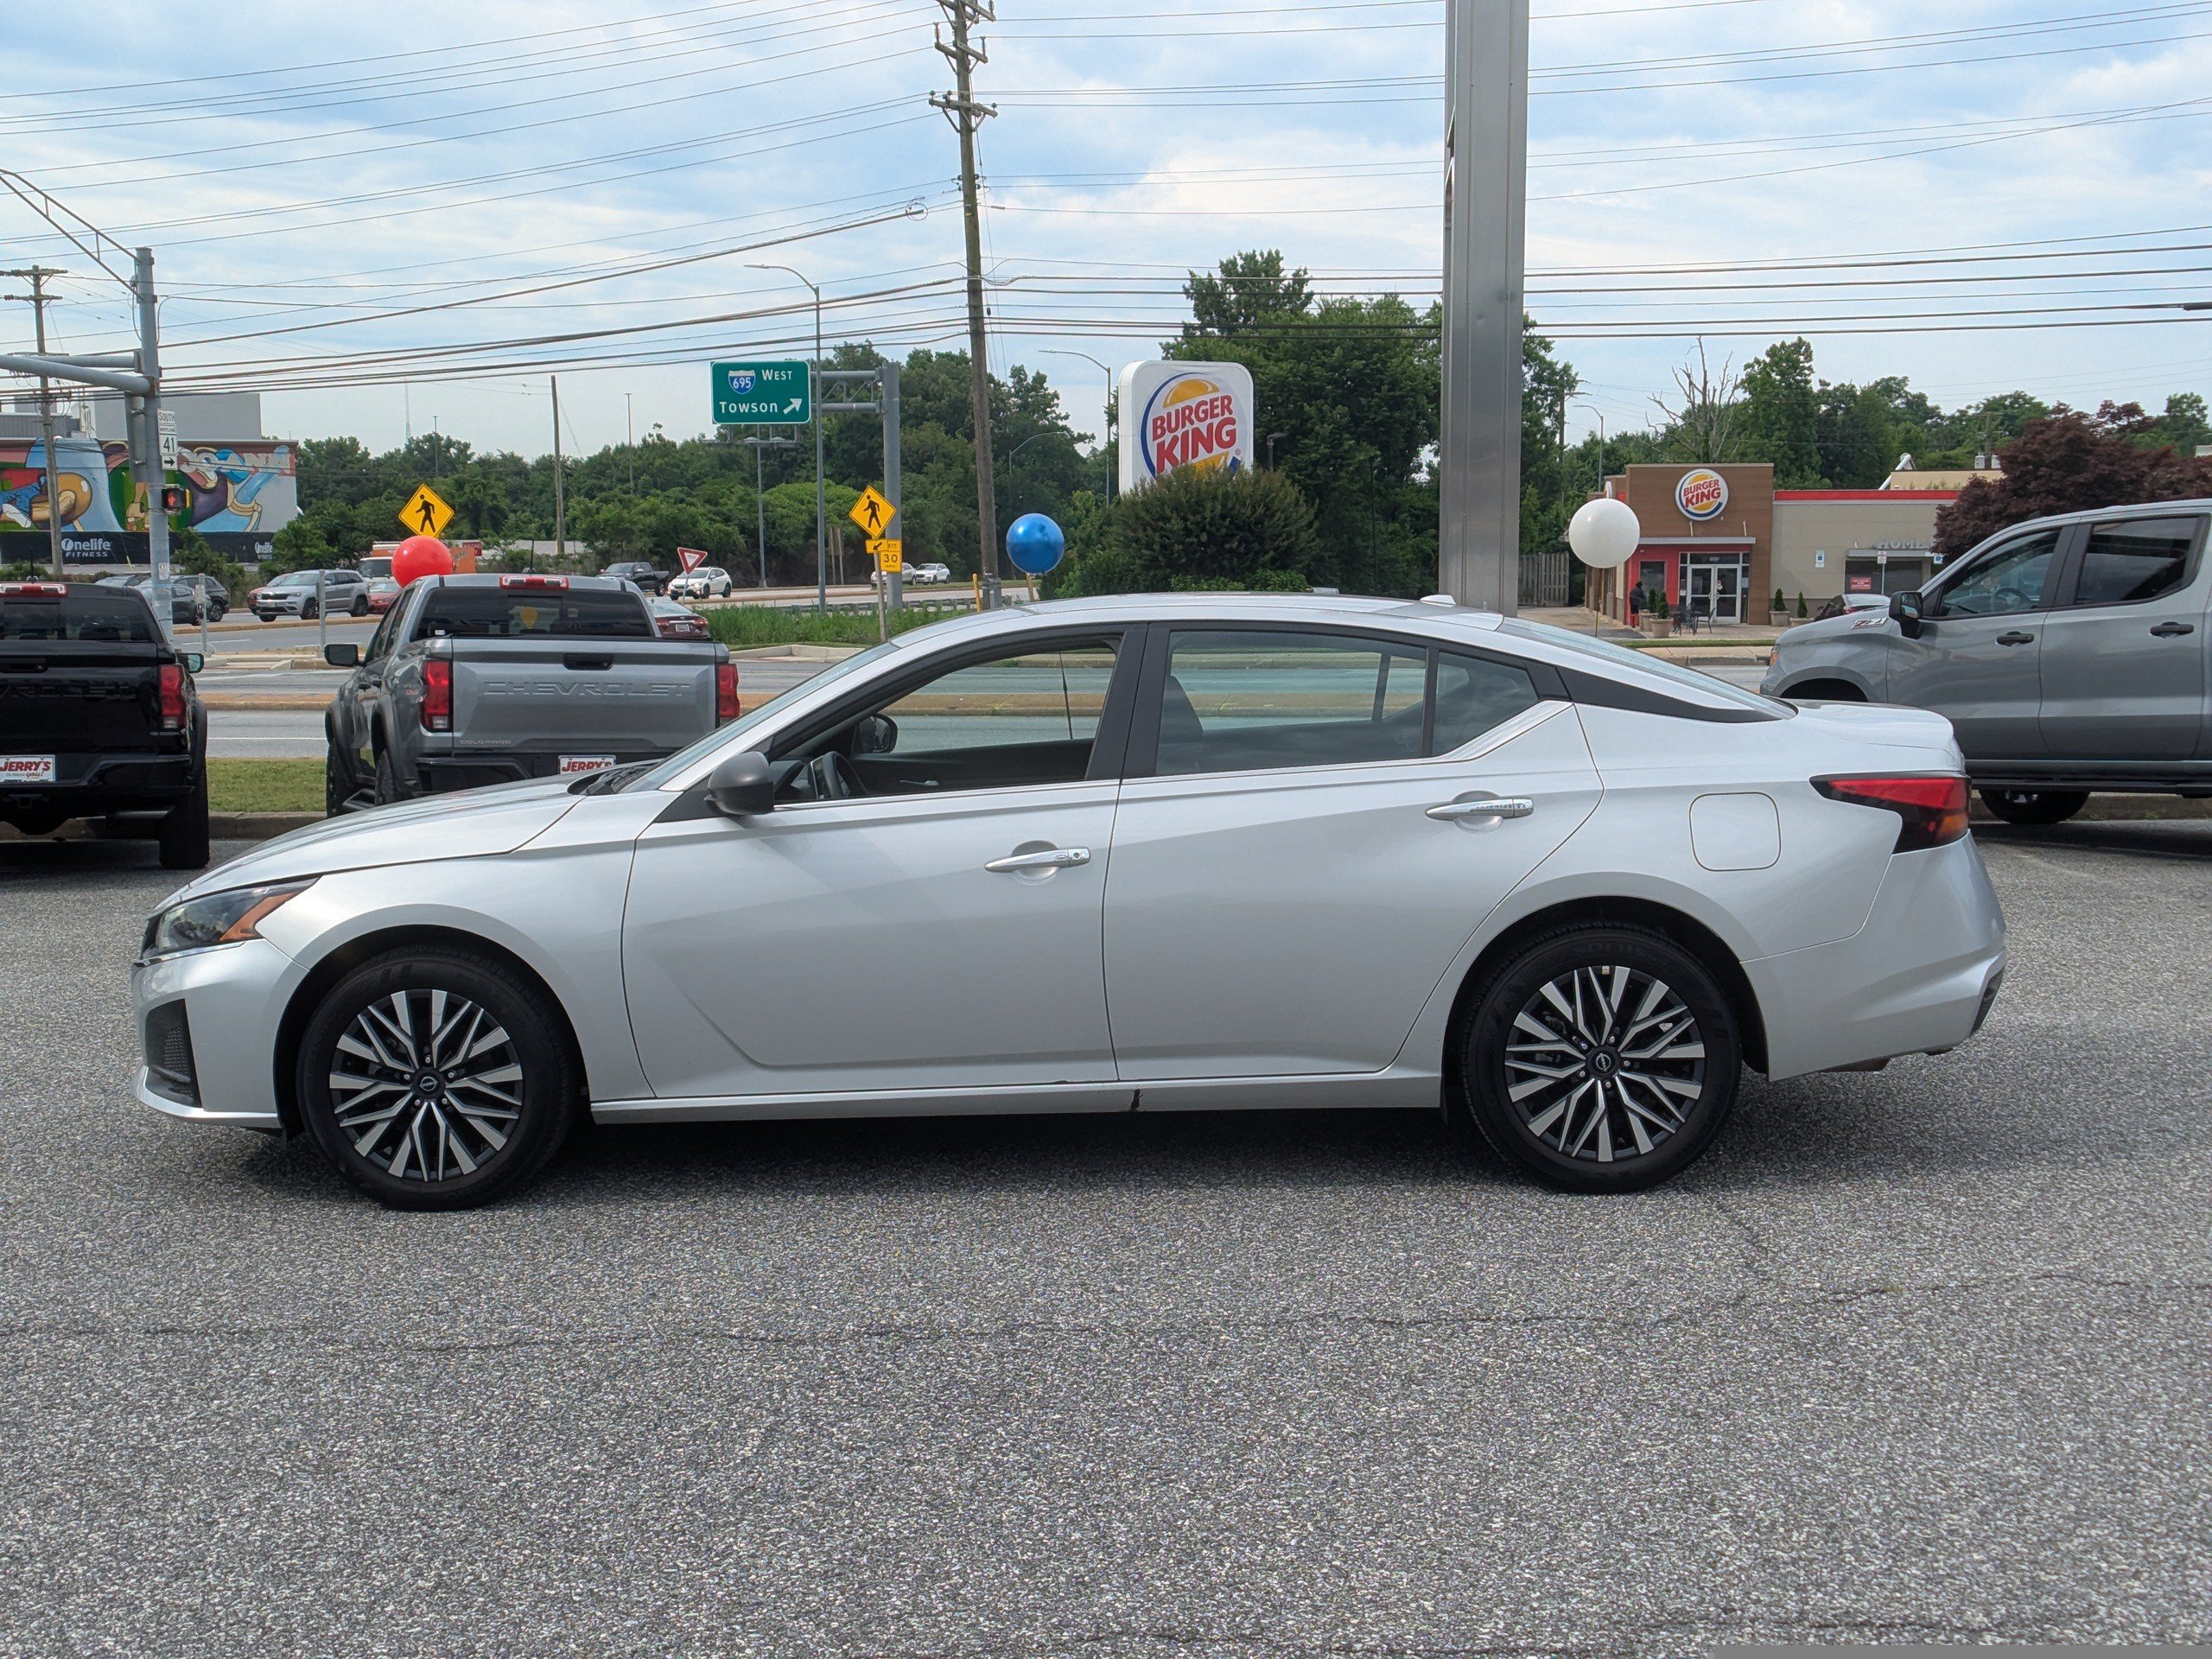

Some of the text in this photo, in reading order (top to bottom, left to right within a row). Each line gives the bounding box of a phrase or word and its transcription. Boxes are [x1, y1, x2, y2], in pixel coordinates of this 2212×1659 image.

[733, 378, 752, 389] 695
[1152, 394, 1233, 442] BURGER
[163, 437, 175, 452] 41
[1156, 416, 1236, 474] KING
[1683, 480, 1719, 497] BURGER
[1685, 487, 1721, 509] KING
[61, 537, 111, 551] Onelife
[883, 553, 898, 563] 30
[484, 681, 690, 696] CHEVROLET
[0, 760, 51, 772] JERRY'S
